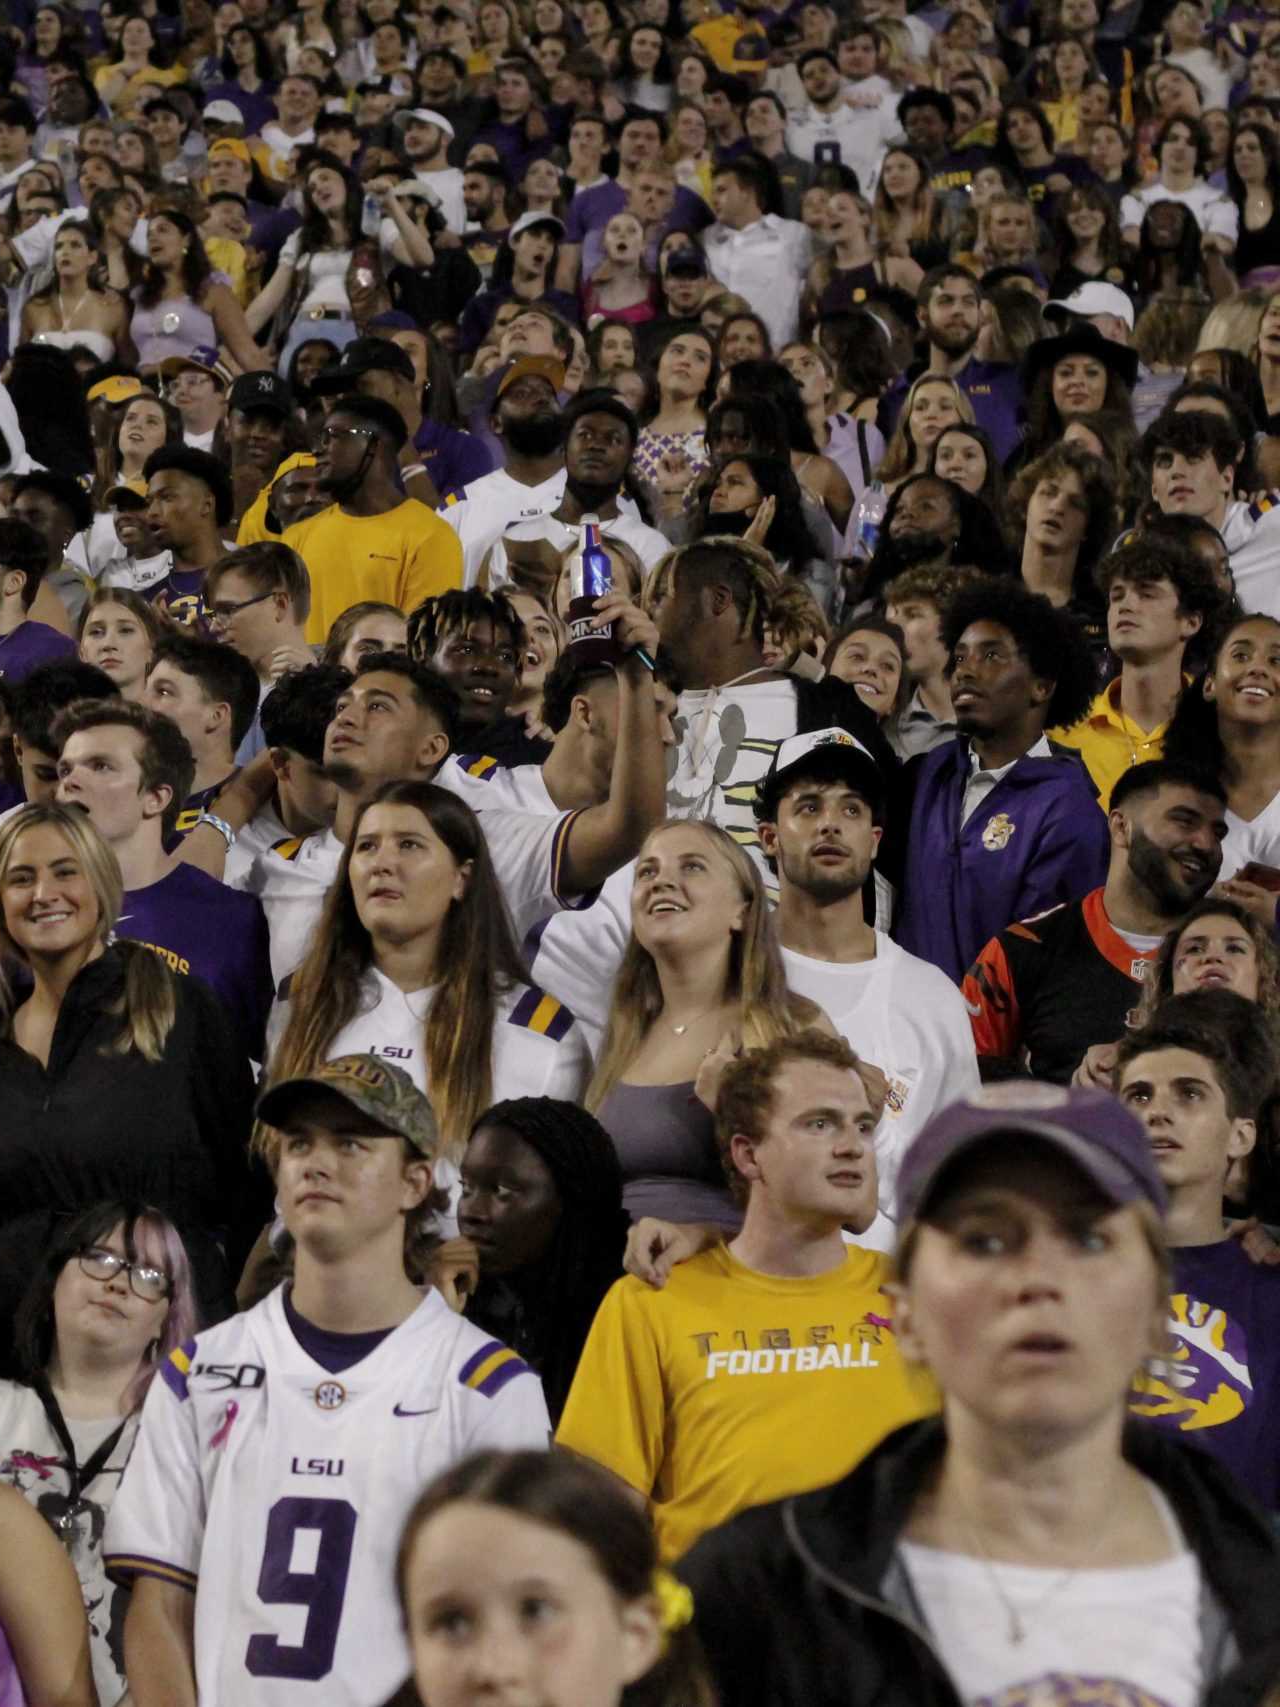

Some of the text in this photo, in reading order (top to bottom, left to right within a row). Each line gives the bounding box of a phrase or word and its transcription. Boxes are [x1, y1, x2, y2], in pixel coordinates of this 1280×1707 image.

[370, 1045, 414, 1060] LSU
[706, 1343, 880, 1381] FOOTBALL
[291, 1457, 344, 1477] LSU
[244, 1496, 358, 1681] 9
